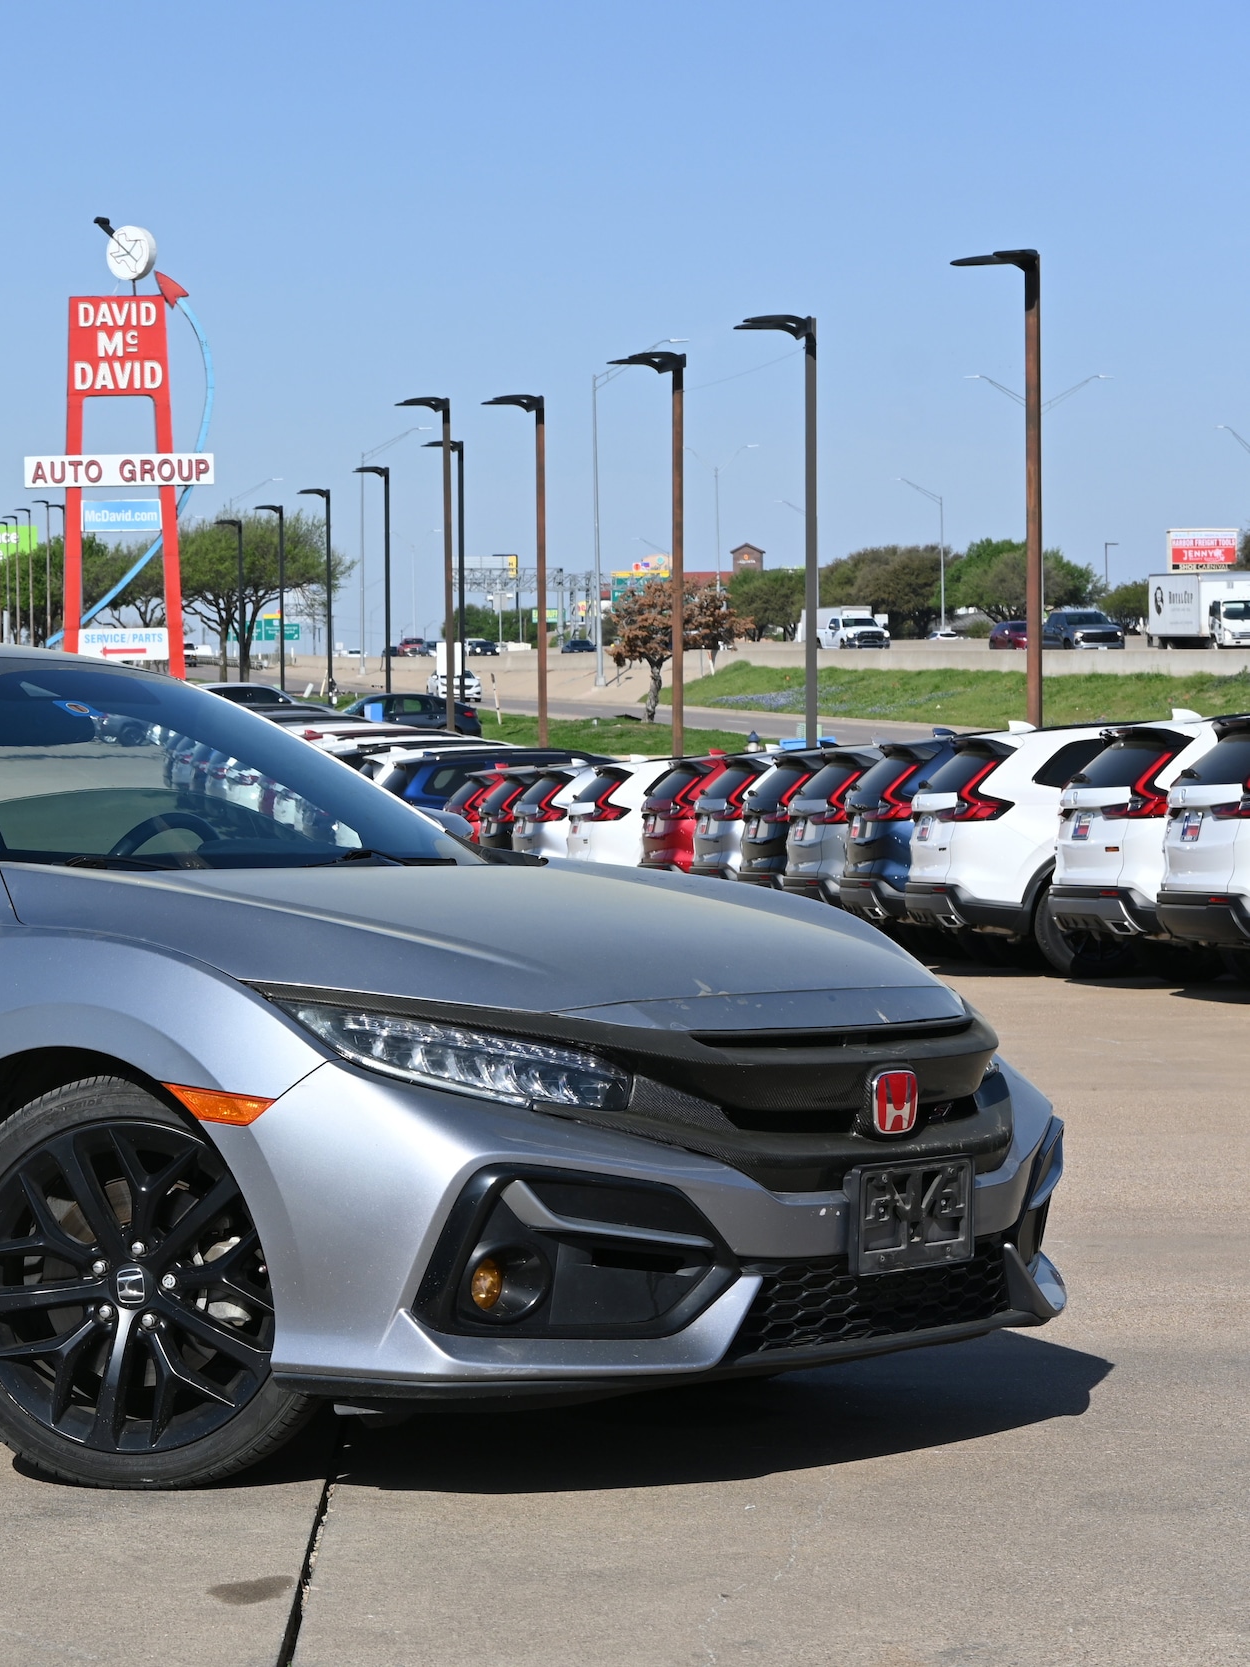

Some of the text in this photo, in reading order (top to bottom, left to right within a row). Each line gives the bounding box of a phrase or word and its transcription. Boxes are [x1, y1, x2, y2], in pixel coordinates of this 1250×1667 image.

[77, 302, 157, 327] DAVID
[73, 360, 163, 390] DAVID
[31, 458, 210, 484] AUTO GROUP
[84, 509, 158, 522] McDavid.com
